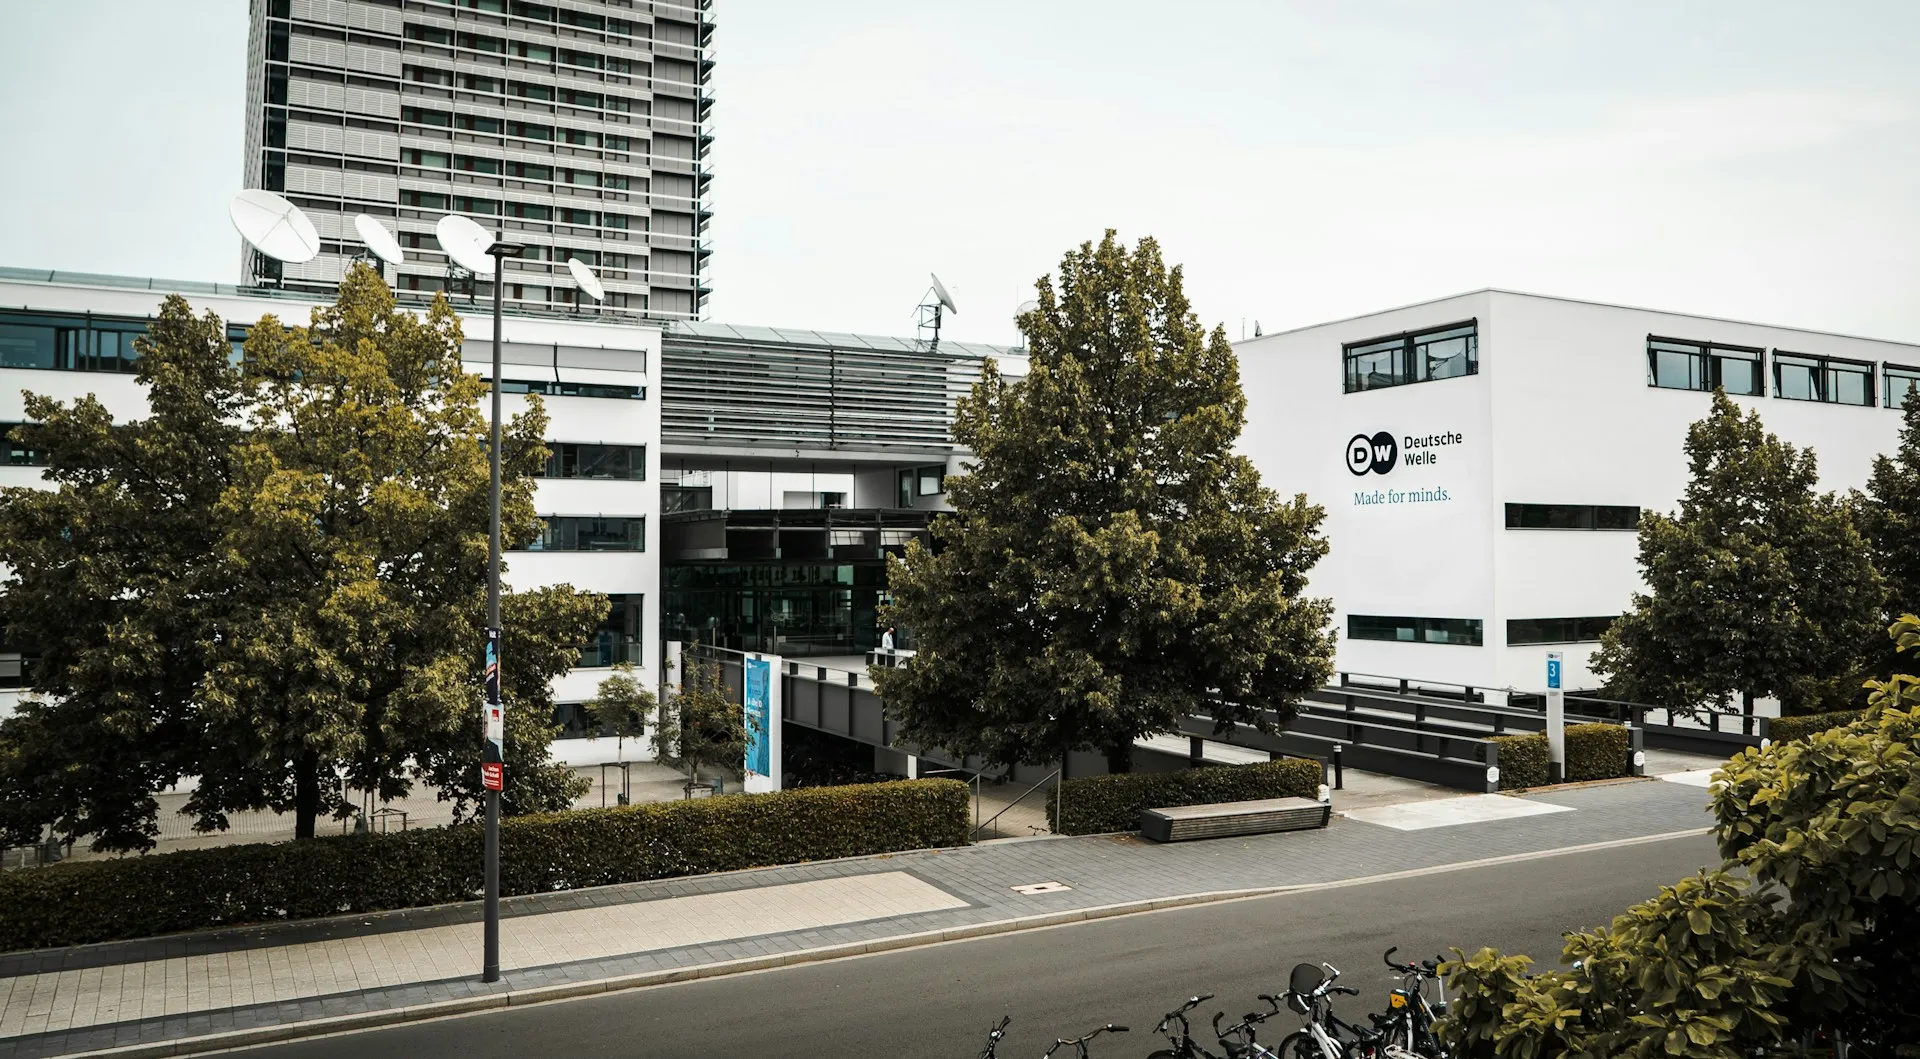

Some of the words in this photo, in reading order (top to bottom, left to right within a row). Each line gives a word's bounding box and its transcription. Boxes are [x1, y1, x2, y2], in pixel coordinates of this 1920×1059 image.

[1404, 431, 1463, 449] Deutsche
[1404, 451, 1437, 466] Welle
[1353, 490, 1385, 505] Made
[1388, 488, 1405, 503] for
[1408, 486, 1451, 503] minds.
[1550, 663, 1556, 677] 3
